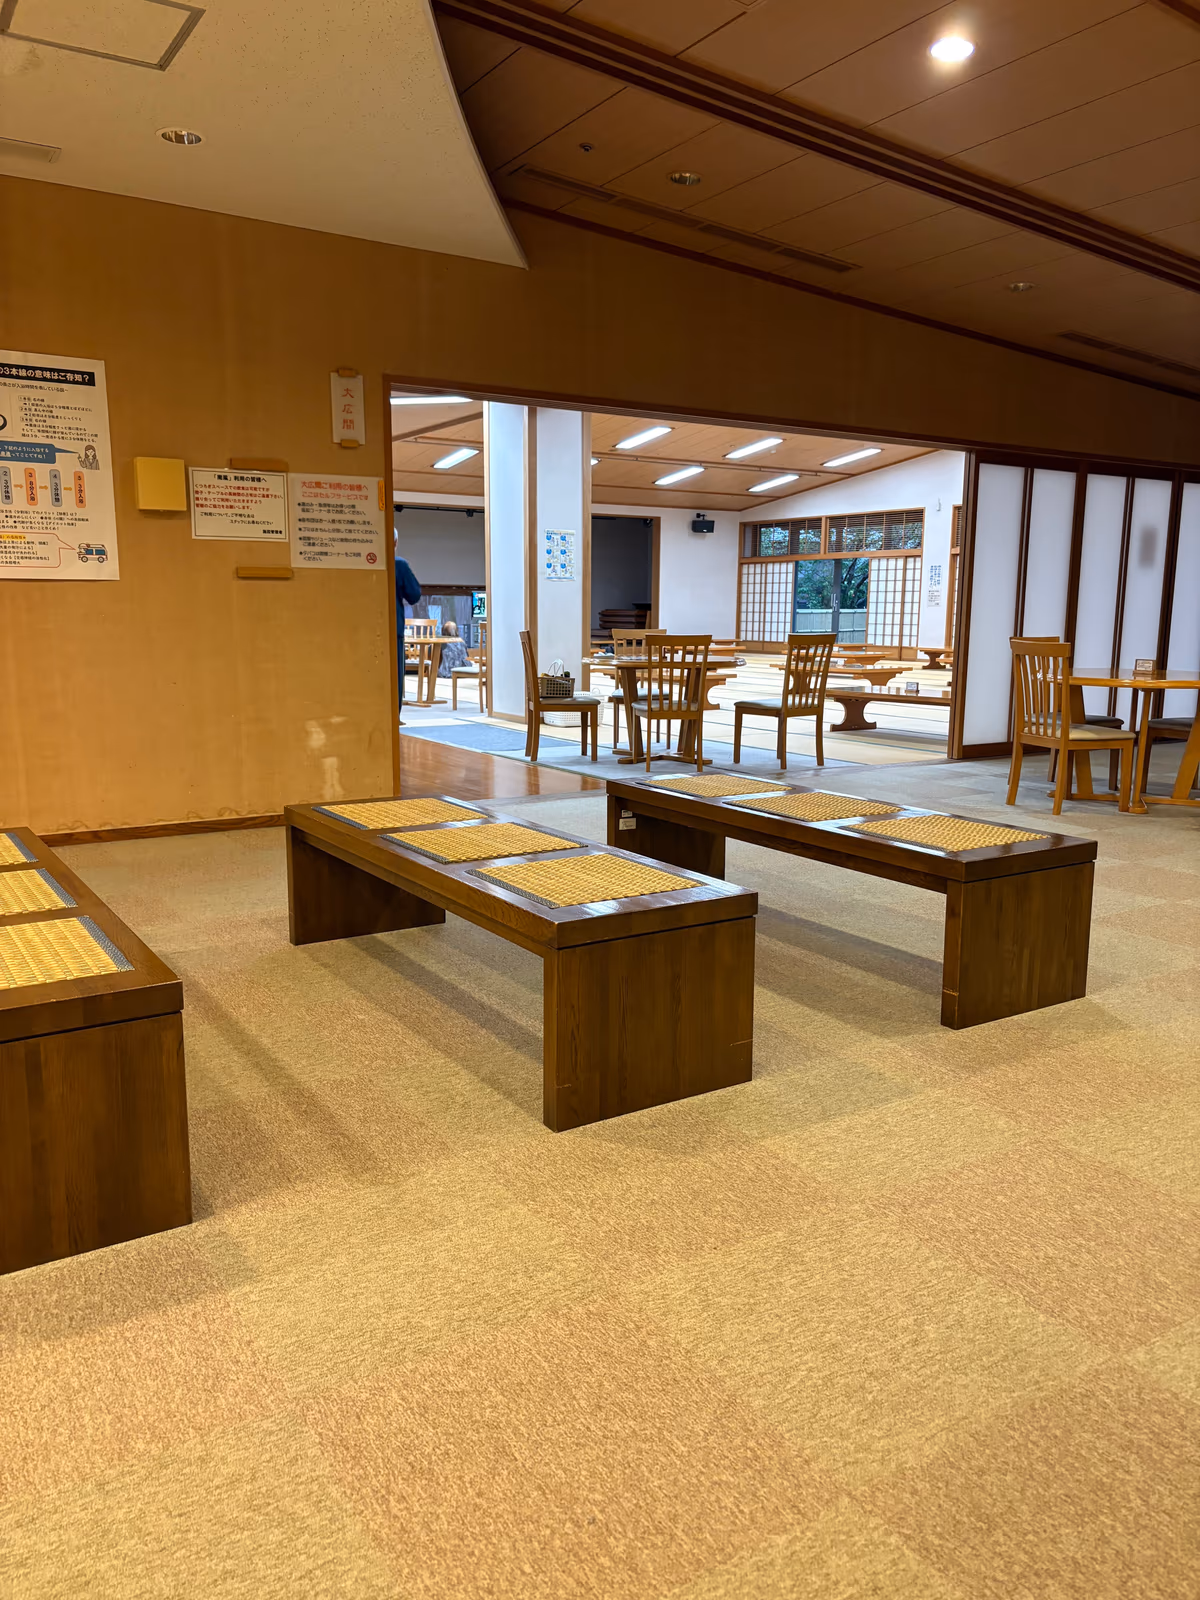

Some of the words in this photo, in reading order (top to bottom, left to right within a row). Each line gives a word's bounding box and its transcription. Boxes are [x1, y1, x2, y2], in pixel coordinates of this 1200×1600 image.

[342, 388, 354, 431] 大広間
[302, 491, 368, 500] ここはセルフサービスです
